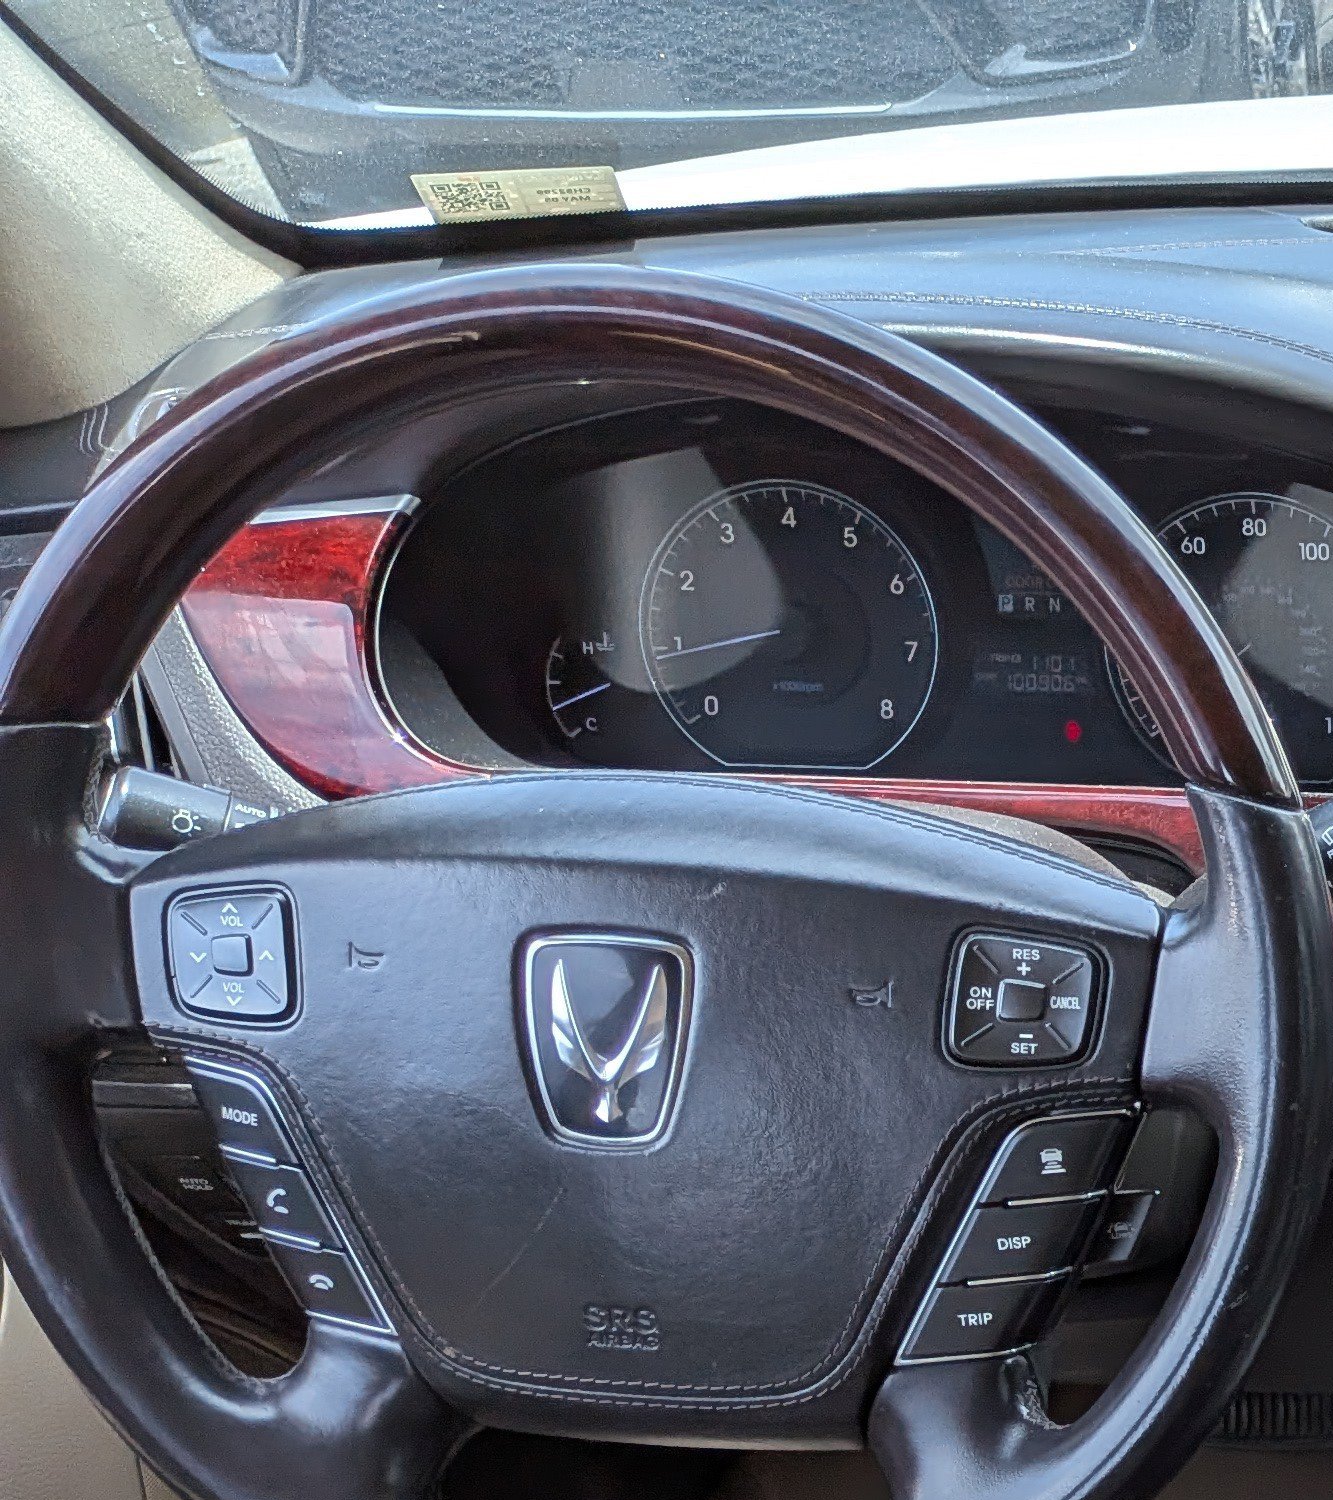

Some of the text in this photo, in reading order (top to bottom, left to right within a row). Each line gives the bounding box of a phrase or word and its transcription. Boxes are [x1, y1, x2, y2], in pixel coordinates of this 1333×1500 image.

[781, 507, 798, 528] 4
[719, 523, 736, 545] 3
[1241, 518, 1267, 537] 80
[843, 526, 859, 547] 5
[1180, 536, 1206, 556] 60
[1299, 542, 1330, 562] 100
[680, 570, 695, 592] 2
[889, 573, 905, 594] 6
[1024, 596, 1036, 612] R
[582, 641, 594, 655] H
[672, 636, 684, 652] 1
[904, 641, 919, 663] 7
[703, 695, 719, 717] 0
[879, 699, 895, 721] 8
[585, 717, 598, 731] C
[234, 803, 267, 819] AUTO
[219, 915, 244, 928] VOL
[1012, 948, 1041, 961] RES
[222, 981, 245, 994] VOL
[969, 986, 993, 999] ON
[966, 997, 995, 1011] OFF
[1049, 996, 1081, 1010] CANCEL
[1010, 1042, 1038, 1055] SET
[220, 1106, 259, 1127] MODE
[996, 1235, 1032, 1251] DISP
[583, 1304, 661, 1335] SRS
[956, 1312, 993, 1328] TRIP
